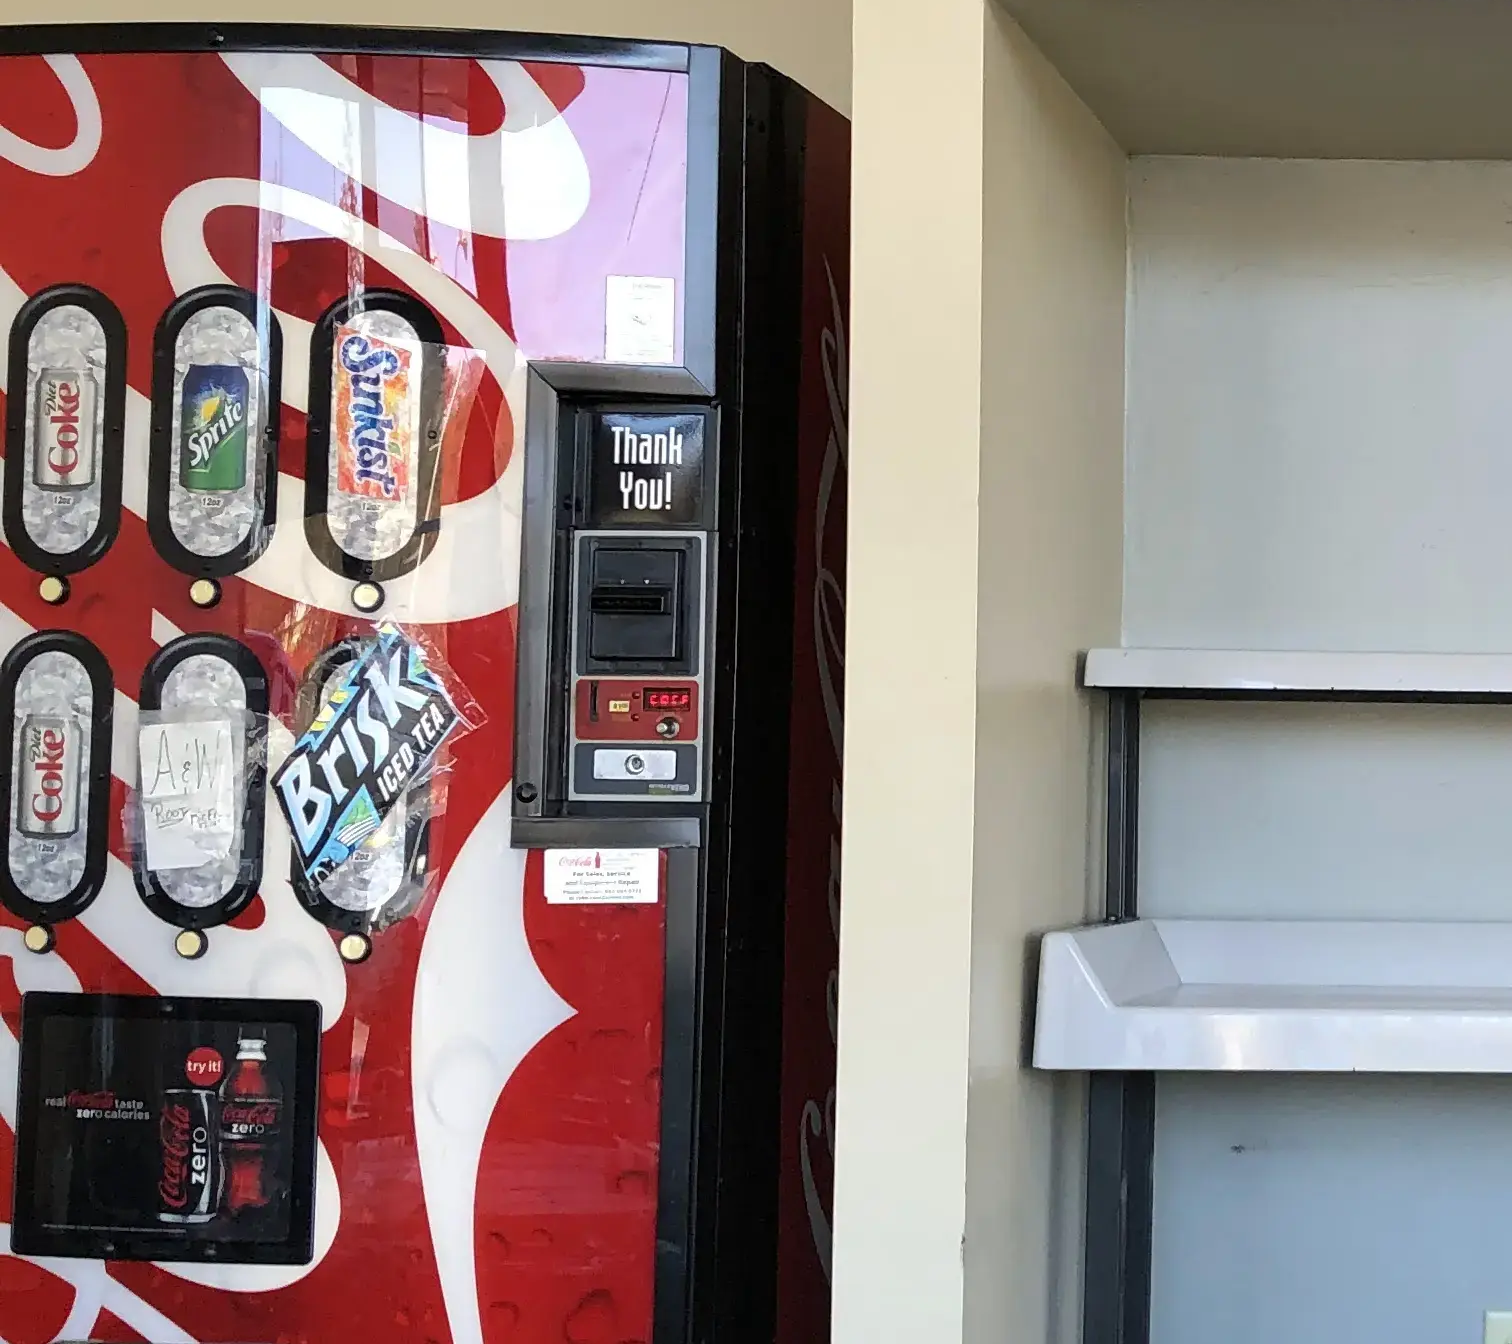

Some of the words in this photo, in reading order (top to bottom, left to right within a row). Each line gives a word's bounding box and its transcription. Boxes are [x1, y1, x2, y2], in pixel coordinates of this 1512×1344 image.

[48, 379, 80, 476] Coke
[188, 399, 243, 467] Sprite
[341, 336, 399, 496] Sunkist
[611, 426, 683, 465] Thank
[202, 497, 222, 507] 12oz
[619, 471, 672, 510] You!
[376, 741, 414, 802] ICED
[411, 702, 445, 751] TEA
[32, 729, 66, 822] Coke
[187, 1060, 206, 1075] try
[208, 1060, 222, 1073] it!
[45, 1096, 66, 1108] real
[114, 1098, 144, 1110] taste
[76, 1108, 103, 1119] zero
[104, 1108, 151, 1121] calories
[231, 1122, 265, 1134] zero
[191, 1126, 207, 1185] zero
